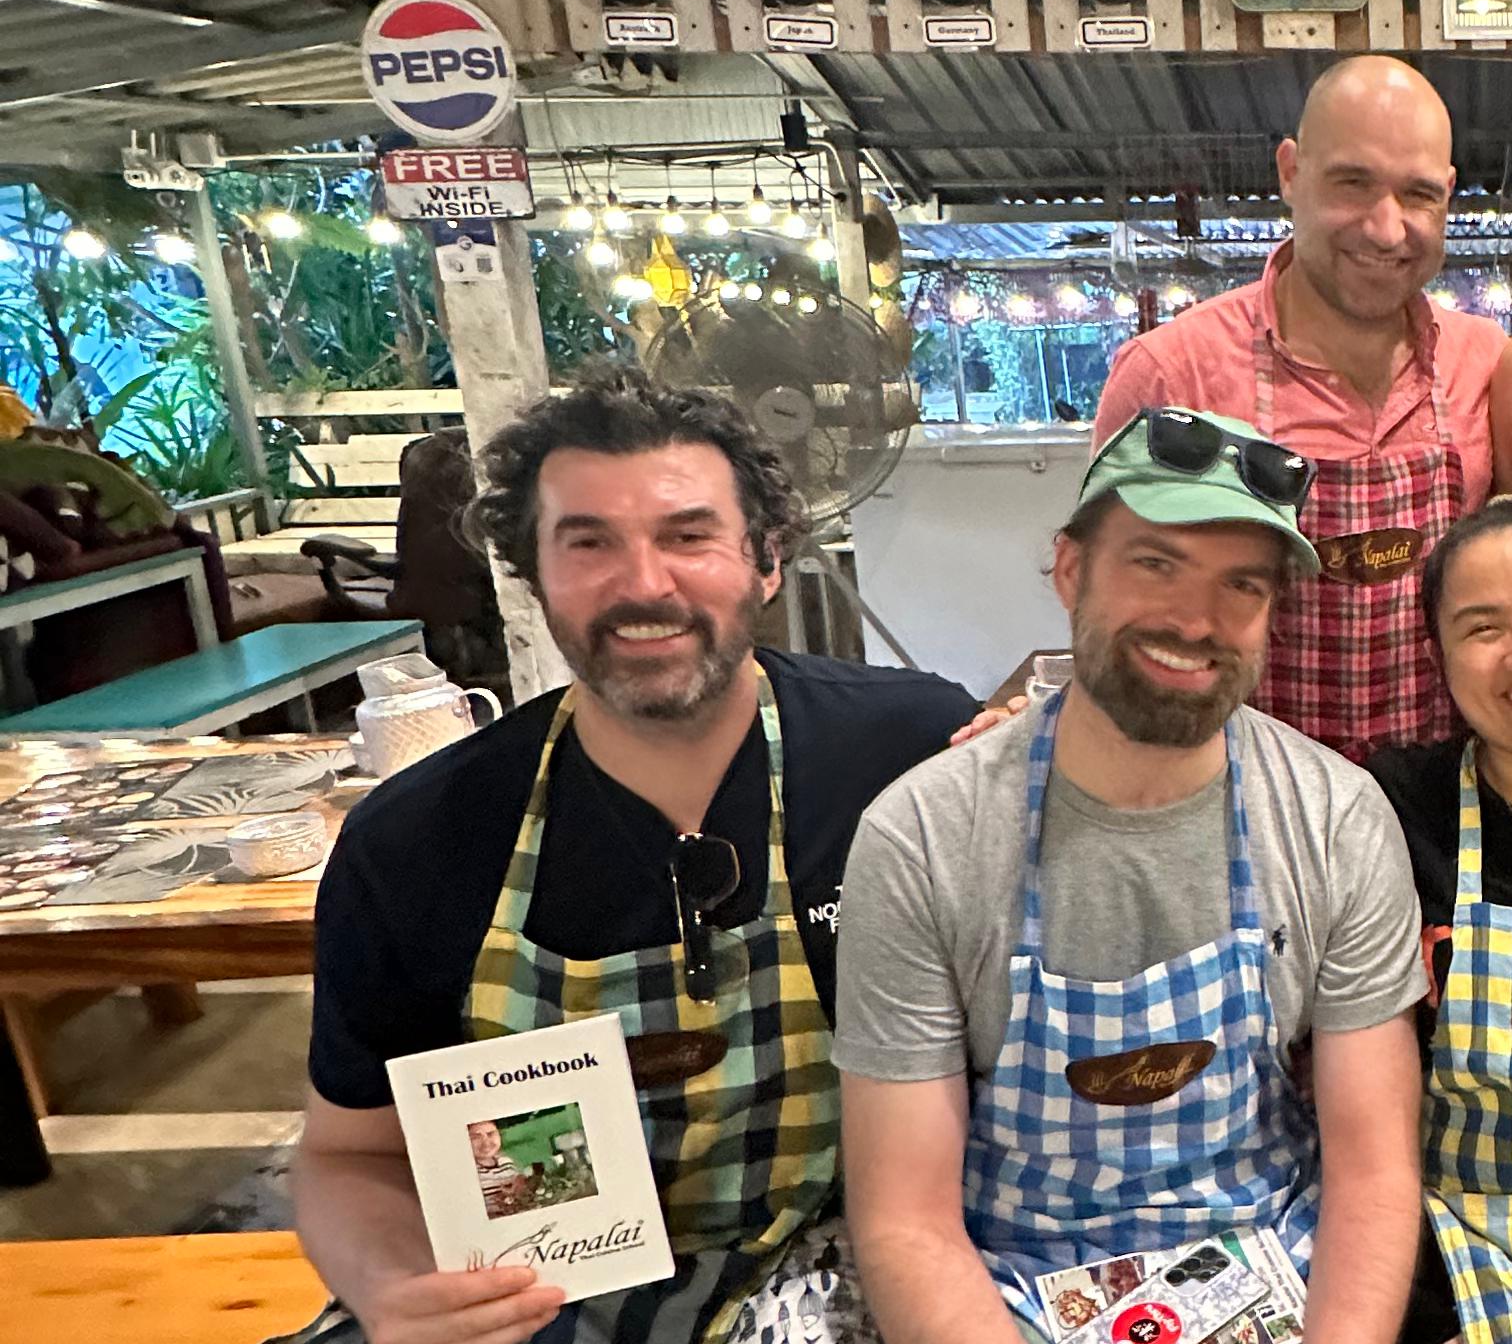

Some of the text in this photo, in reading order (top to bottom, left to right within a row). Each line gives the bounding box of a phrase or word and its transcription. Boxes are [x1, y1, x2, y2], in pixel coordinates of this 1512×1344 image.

[369, 46, 508, 86] PEPSI
[394, 153, 516, 181] FREE
[420, 201, 506, 217] INSIDE
[422, 1052, 599, 1099] Thai Cookbook
[525, 1218, 644, 1267] Napalai
